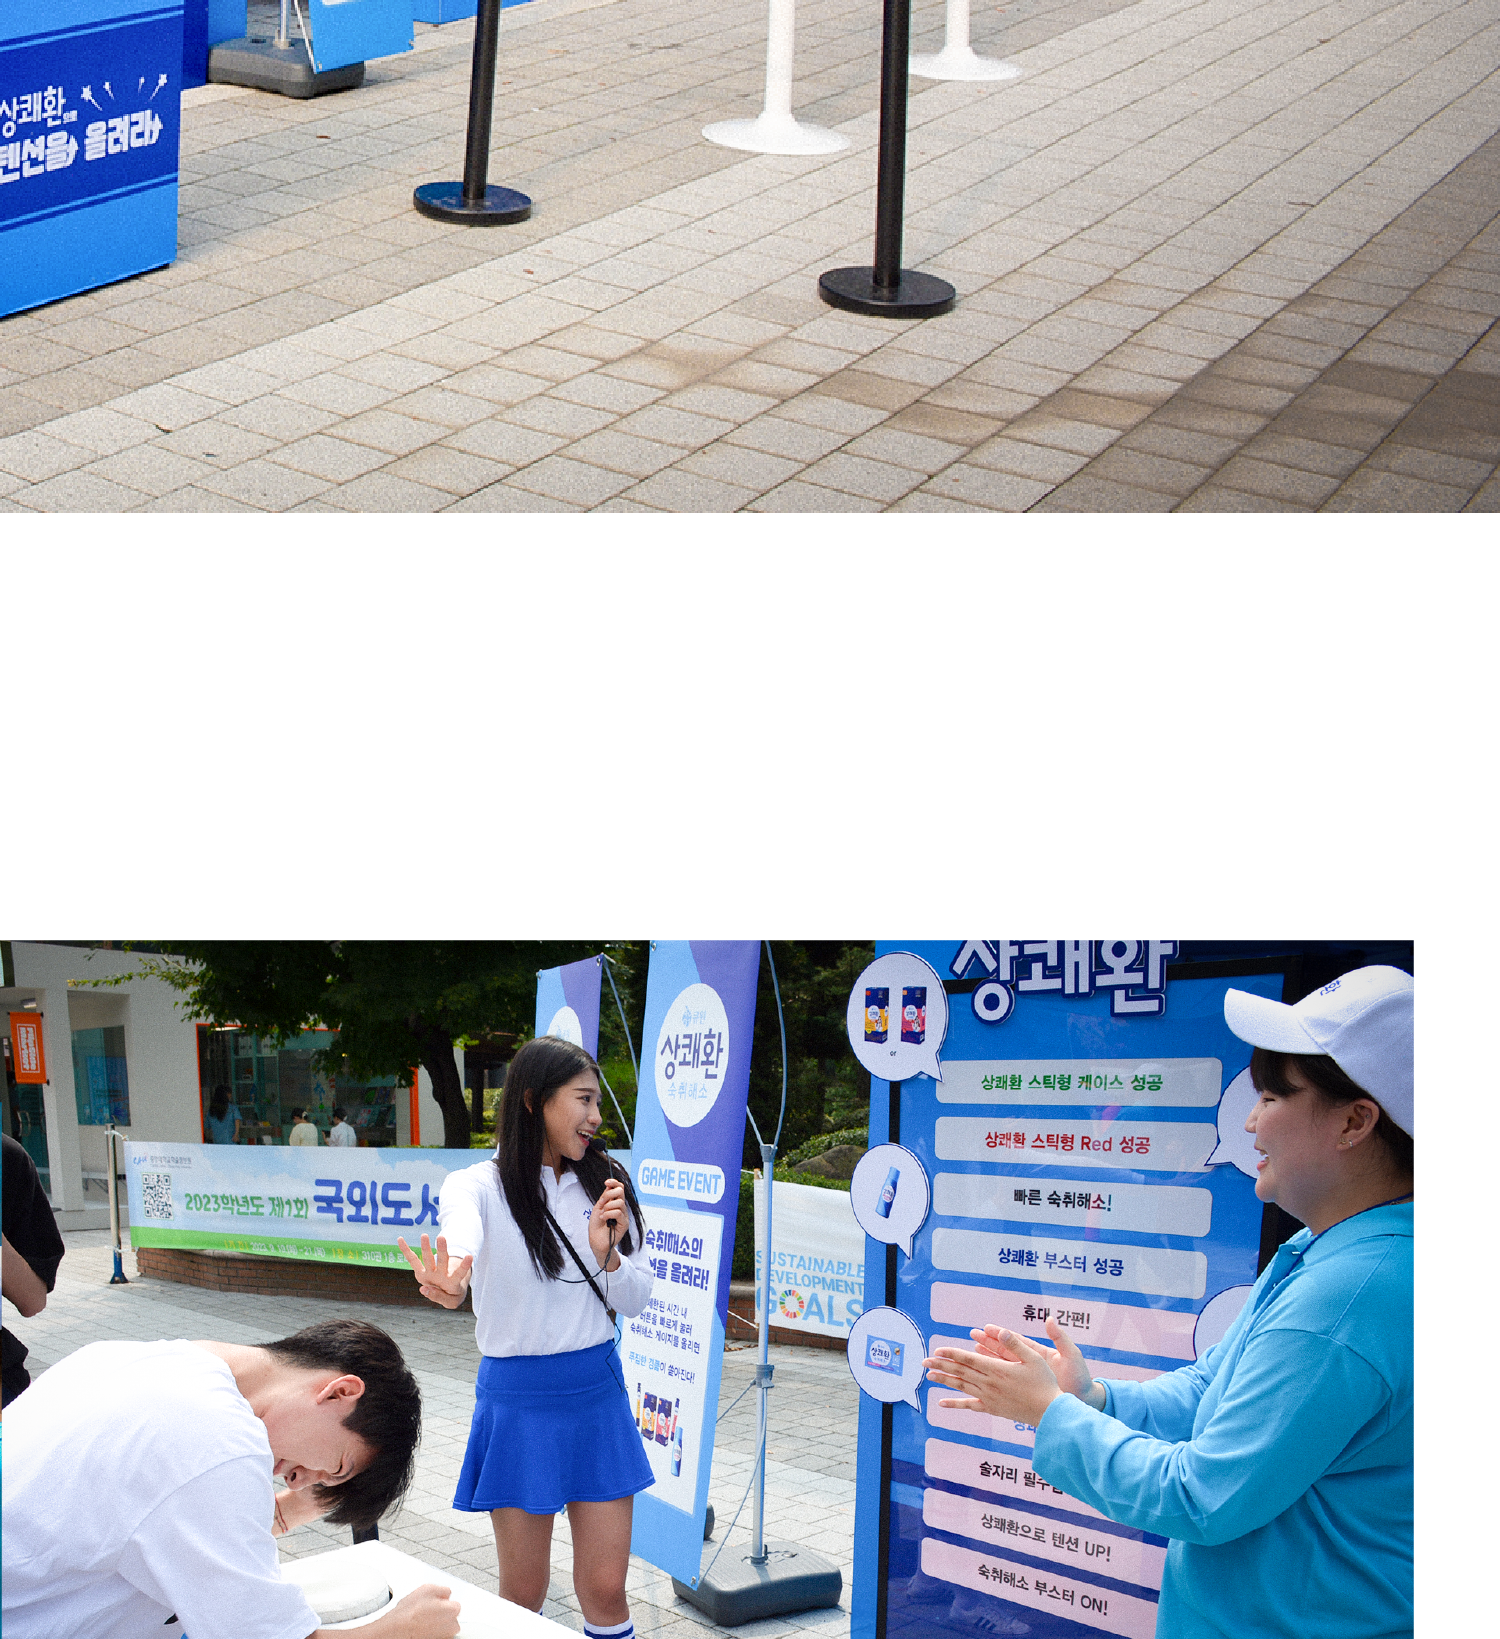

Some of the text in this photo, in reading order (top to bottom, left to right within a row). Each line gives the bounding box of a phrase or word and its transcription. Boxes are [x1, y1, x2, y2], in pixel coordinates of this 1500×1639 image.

[951, 940, 1179, 1024] 상쾌환
[661, 1028, 723, 1079] 상쾌환
[668, 1082, 707, 1100] 숙취해소
[982, 1073, 1163, 1091] 상쾌환 스틱형 케이스 성공
[985, 1132, 1150, 1154] 상쾌환 스틱형 Red 성공
[642, 1167, 721, 1194] GAME EVENT
[185, 1194, 309, 1220] 2023학년도 제1회
[1013, 1189, 1112, 1212] 빠른 숙취해소!
[998, 1247, 1124, 1276] 상쾌환 부스터 성공
[671, 1263, 709, 1291] 올려라!
[1023, 1305, 1090, 1330] 휴대 간편!
[630, 1322, 653, 1339] 숙취해소
[681, 1334, 700, 1354] 올리면
[980, 1461, 1017, 1483] 술자리
[981, 1513, 1111, 1561] 상쾌환으로 텐션 UP!
[978, 1564, 1108, 1616] 숙취해소 부스터 ON!
